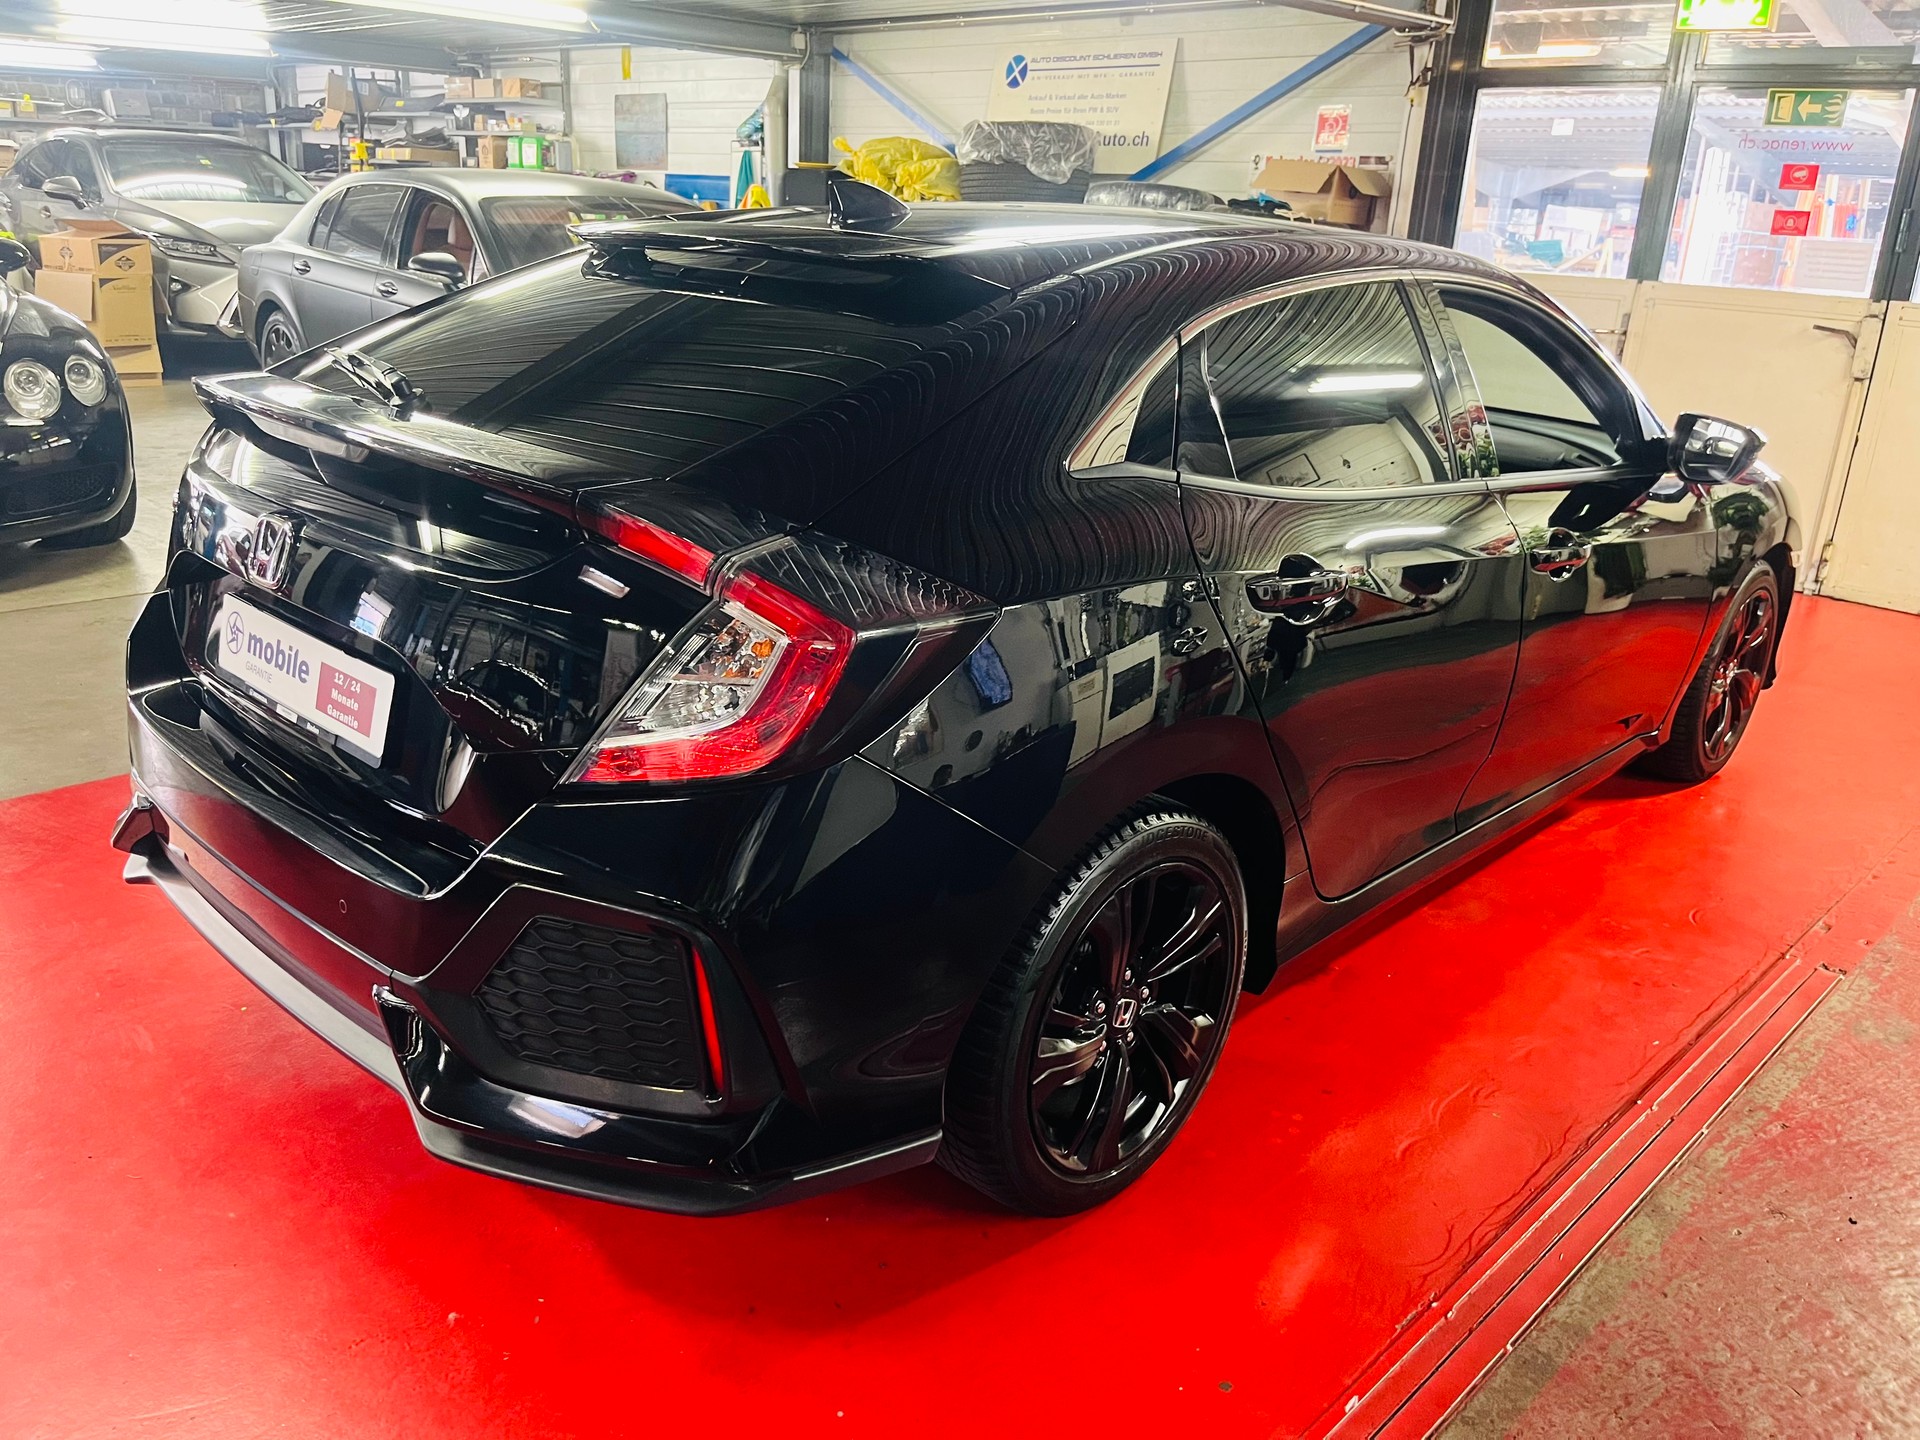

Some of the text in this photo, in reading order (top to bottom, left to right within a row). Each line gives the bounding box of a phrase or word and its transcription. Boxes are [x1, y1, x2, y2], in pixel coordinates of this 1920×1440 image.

[1052, 54, 1092, 63] DISCOUNT
[247, 631, 310, 684] mobile
[245, 660, 273, 684] GARANTIE
[334, 672, 344, 686] 12
[350, 680, 361, 694] 24
[331, 688, 359, 711] Monate
[327, 703, 359, 729] Garantie
